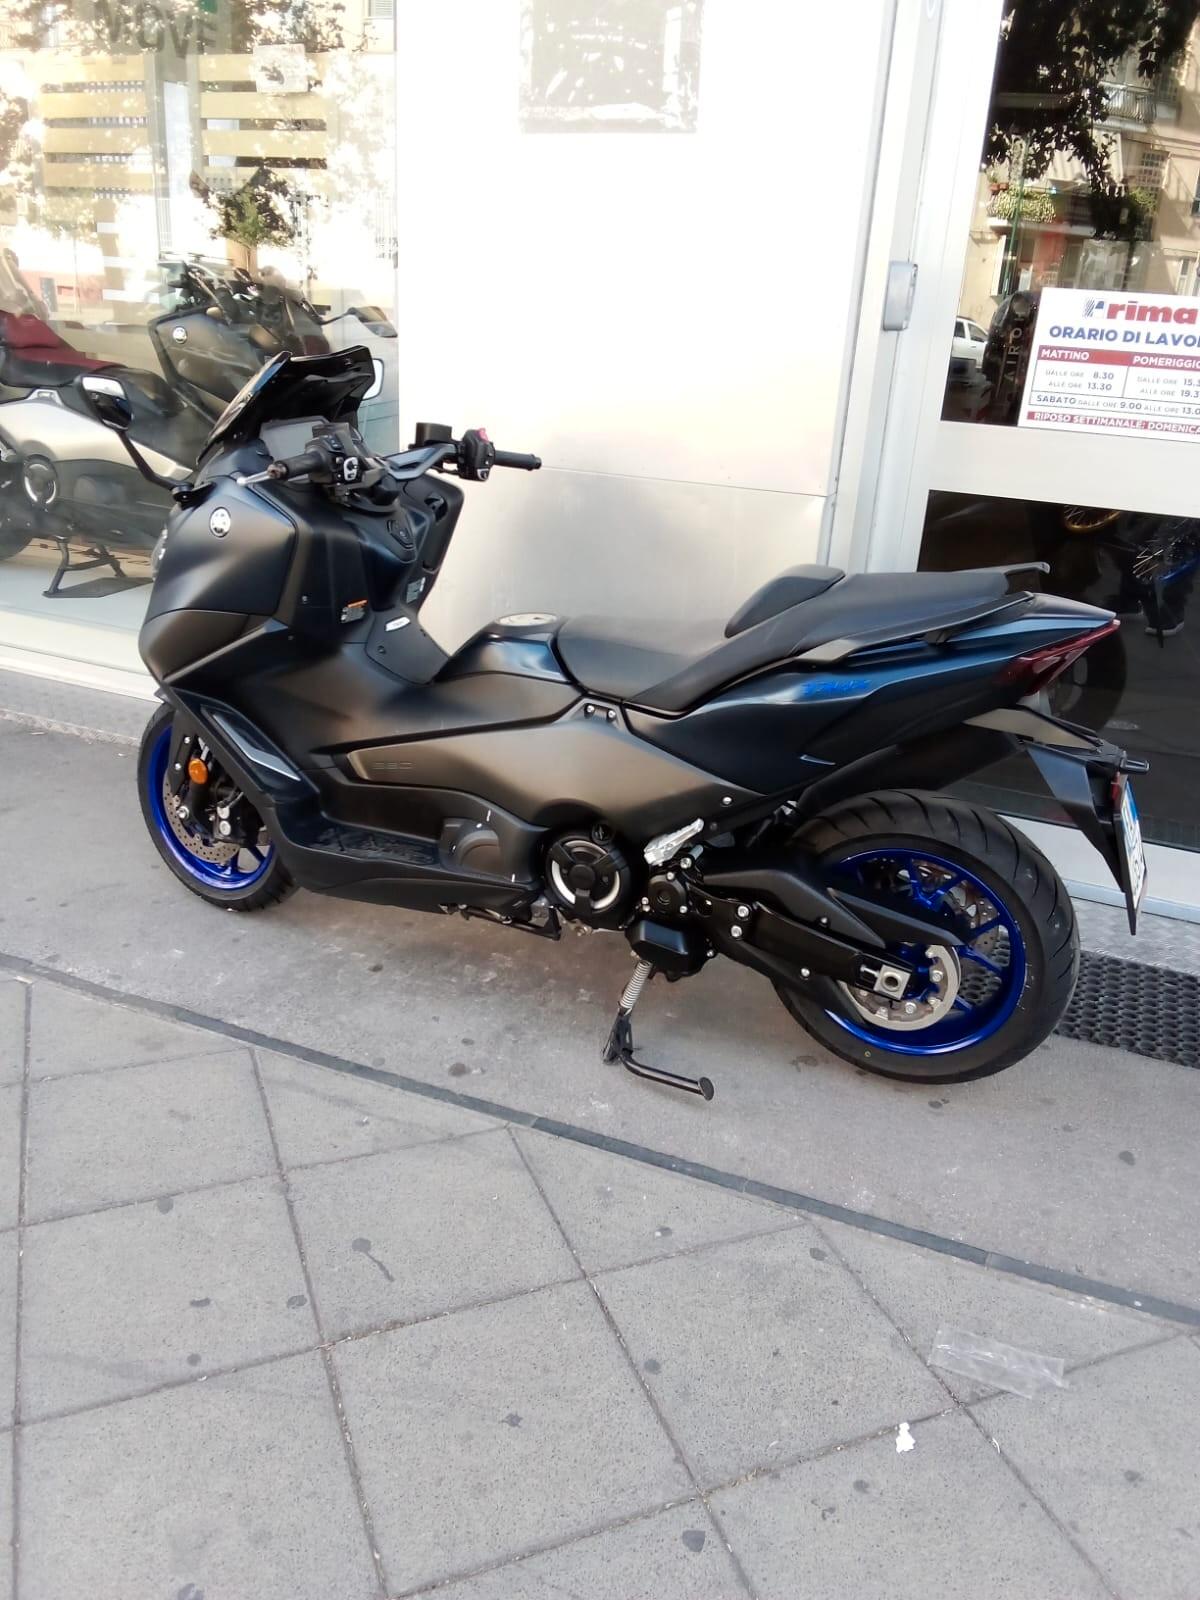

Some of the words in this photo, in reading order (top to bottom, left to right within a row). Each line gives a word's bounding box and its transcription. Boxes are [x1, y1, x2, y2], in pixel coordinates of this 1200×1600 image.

[1049, 325, 1118, 342] ORARIO
[1122, 330, 1141, 343] DI
[1041, 349, 1090, 360] MATTINO
[1132, 355, 1200, 369] POMERIGGIO
[1093, 371, 1114, 380] 8.30
[1087, 382, 1112, 390] 13.30
[1036, 394, 1077, 405] SABATO
[1120, 402, 1142, 410] 9.00
[1033, 412, 1072, 422] RIPOSO
